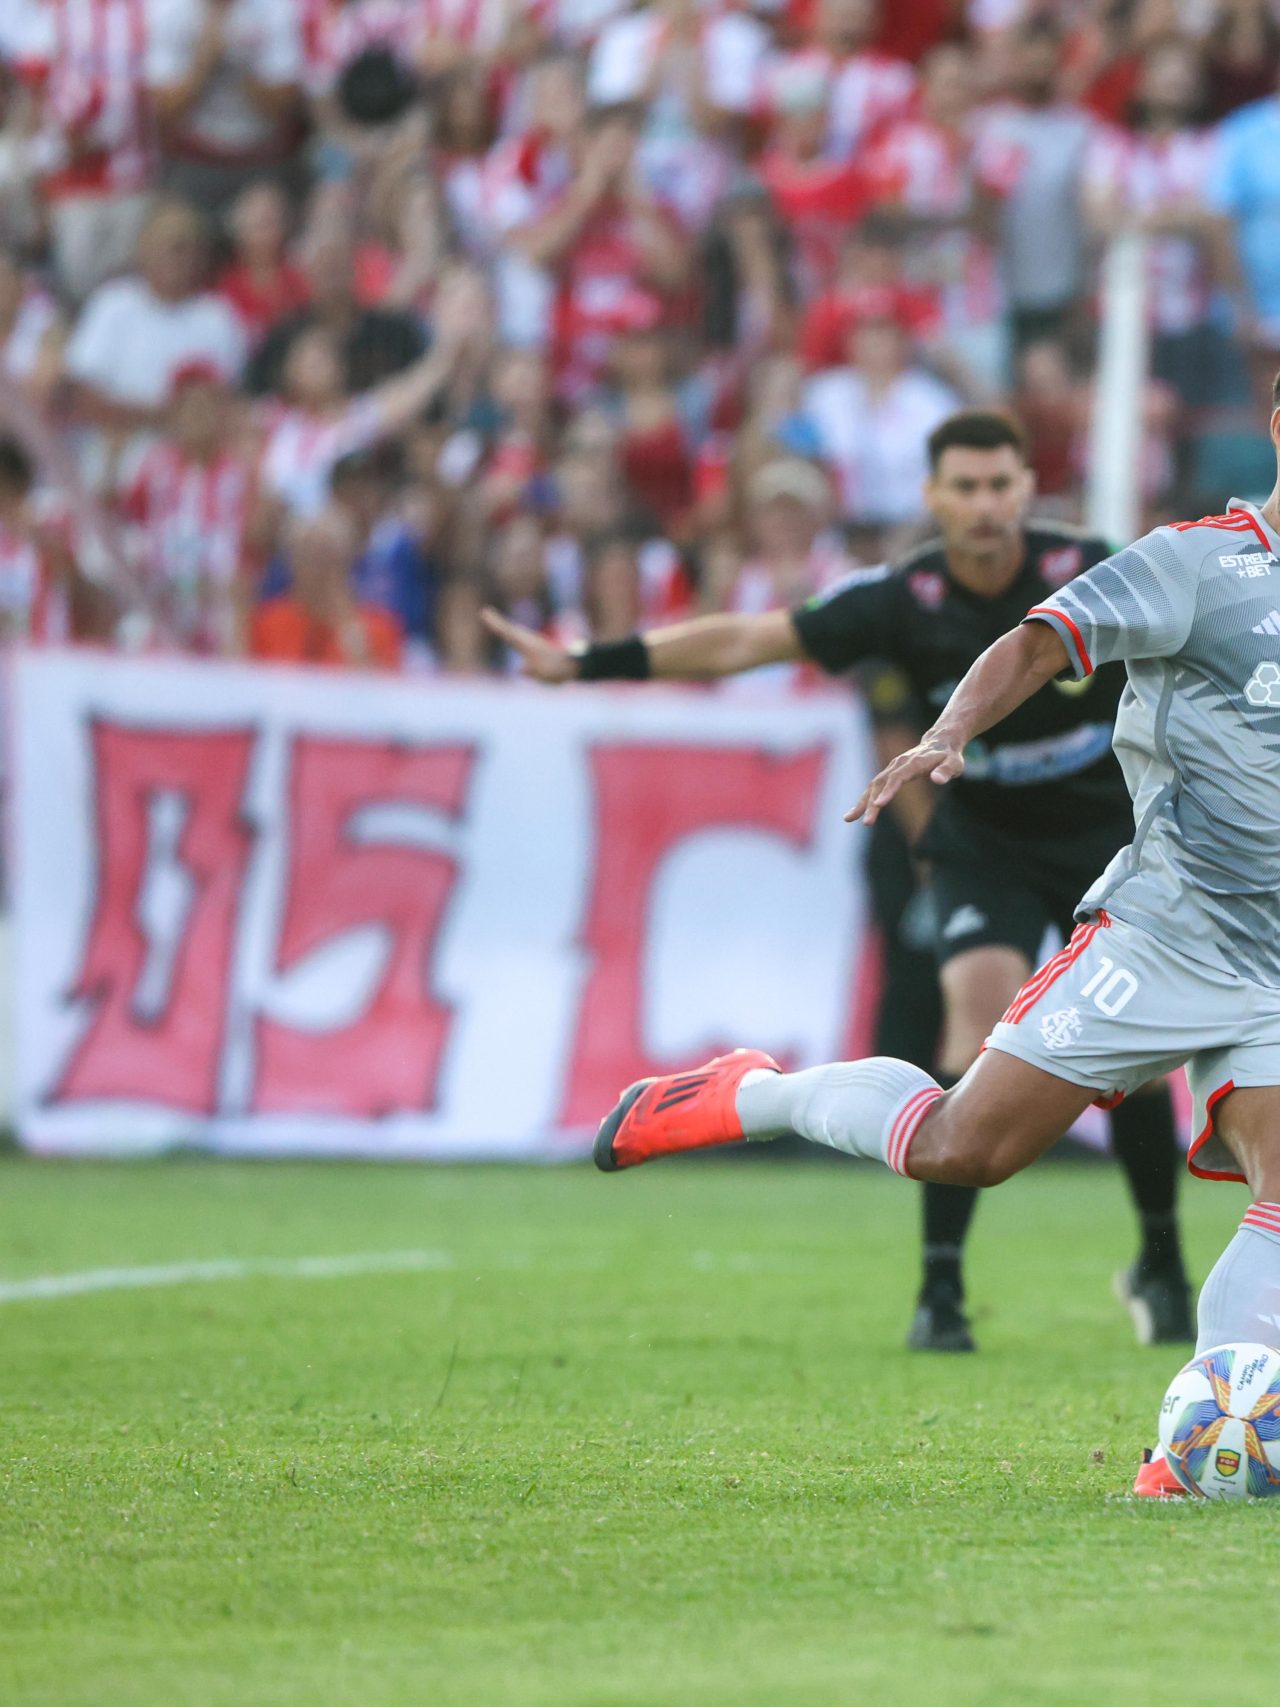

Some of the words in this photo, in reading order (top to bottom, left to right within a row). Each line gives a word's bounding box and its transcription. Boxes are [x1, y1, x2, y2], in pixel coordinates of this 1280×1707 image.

[1218, 551, 1279, 568] ESTRELA
[1245, 563, 1271, 579] BET
[1079, 955, 1139, 1017] 10
